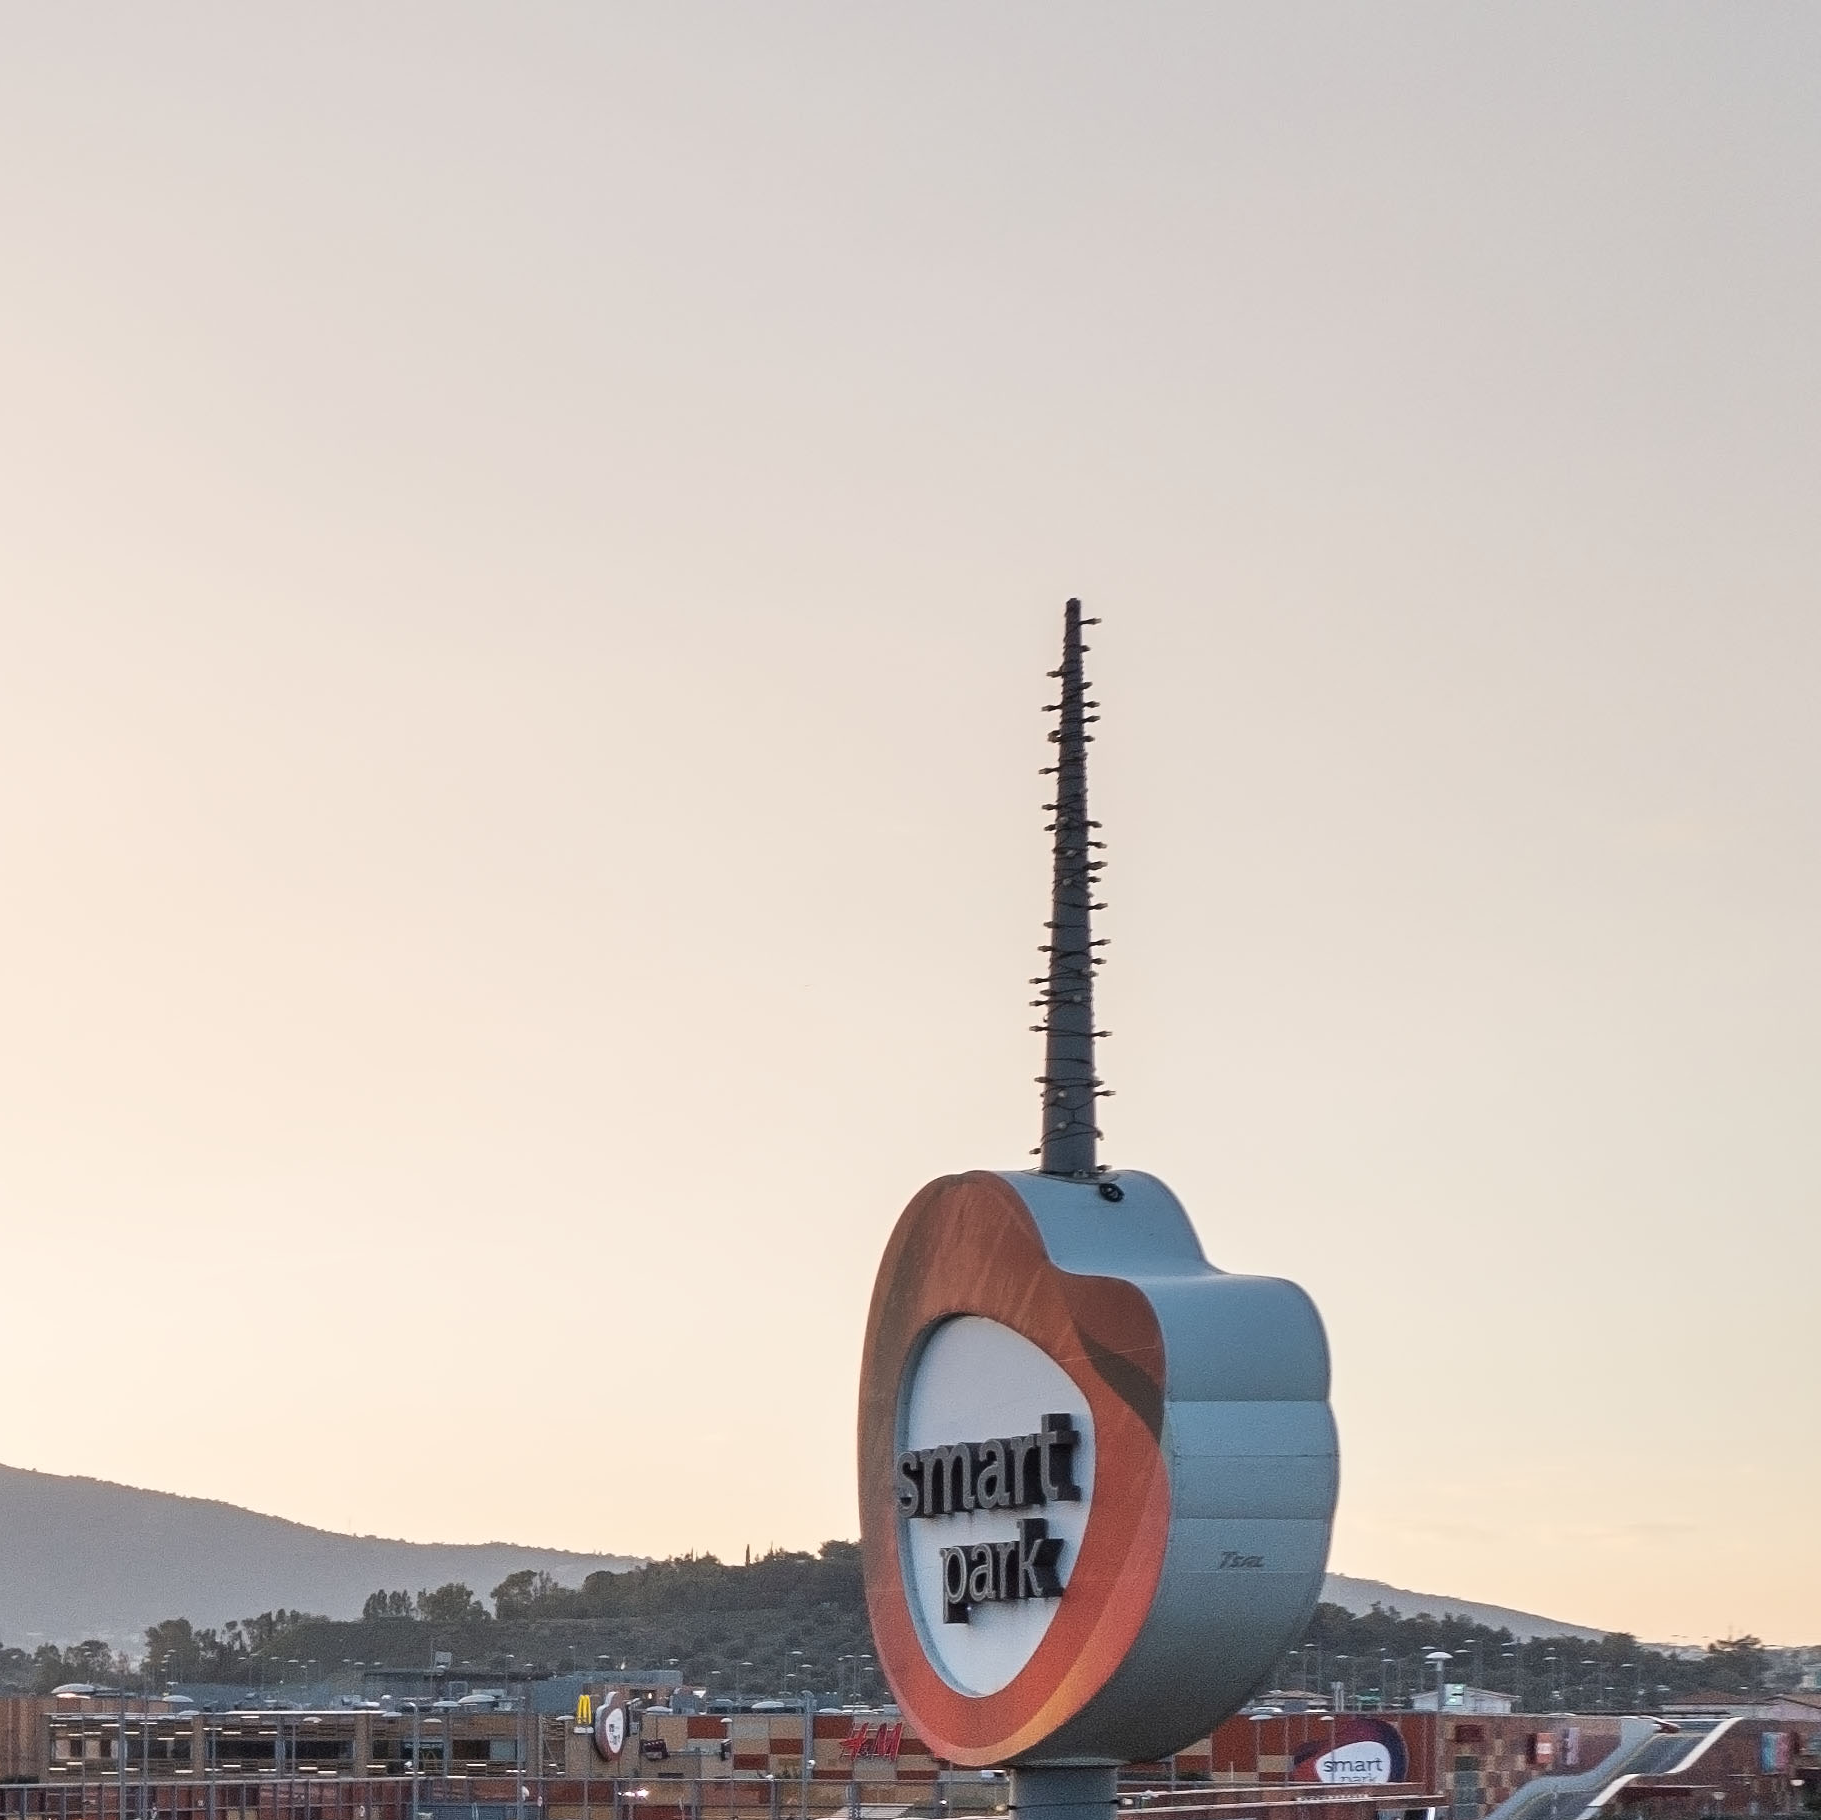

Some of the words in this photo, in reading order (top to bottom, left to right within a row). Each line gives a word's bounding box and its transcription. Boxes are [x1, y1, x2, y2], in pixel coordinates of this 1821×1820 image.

[896, 1413, 1081, 1519] smart
[940, 1518, 1065, 1624] park
[1323, 1757, 1383, 1773] smart
